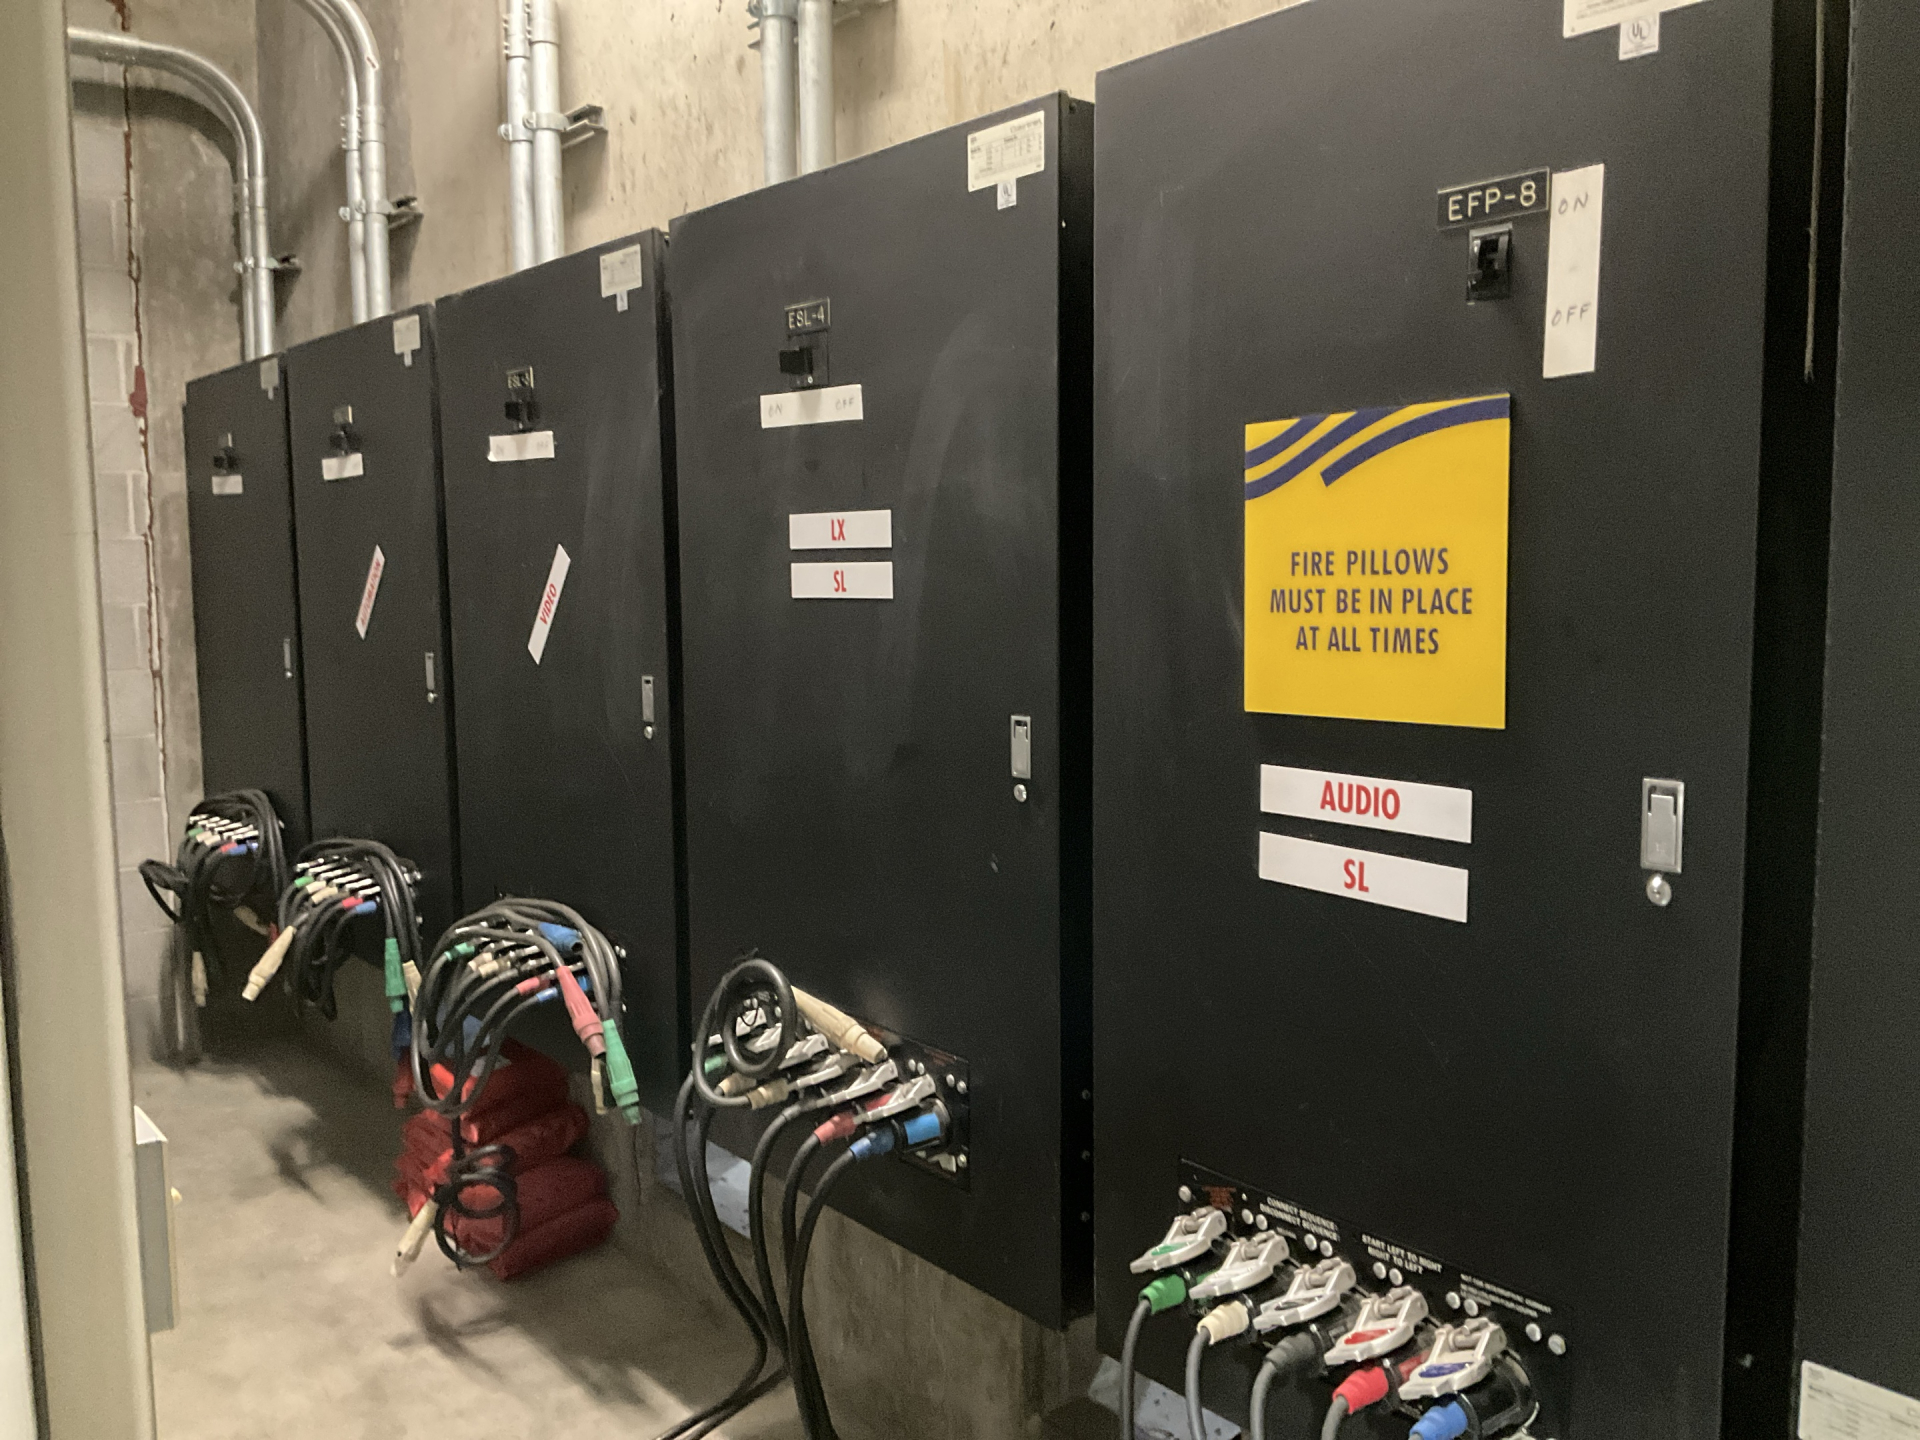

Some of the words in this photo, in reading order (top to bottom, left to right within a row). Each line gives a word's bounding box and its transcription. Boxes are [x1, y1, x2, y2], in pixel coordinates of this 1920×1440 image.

[1448, 180, 1536, 221] EFP-8
[1558, 192, 1589, 215] ON
[788, 305, 825, 330] ESL-4
[1551, 302, 1591, 327] OFF
[831, 518, 846, 541] LX
[1291, 550, 1335, 577] FIRE
[1347, 547, 1449, 576] PILLOWS
[833, 570, 847, 592] SL
[539, 582, 557, 625] VIDEO
[1270, 588, 1326, 613] MUST
[1336, 588, 1361, 614] BE
[1370, 588, 1393, 615] IN
[1402, 587, 1473, 615] PLACE
[1295, 626, 1320, 651] AT
[1327, 626, 1361, 652] ALL
[1370, 627, 1439, 655] TIMES
[1319, 779, 1401, 821] AUDIO
[1343, 858, 1370, 893] SL
[1362, 1233, 1385, 1250] START
[1387, 1244, 1405, 1258] LEFT
[1407, 1251, 1418, 1263] TO
[1393, 1256, 1404, 1268] TO
[1405, 1259, 1423, 1274] LEFT
